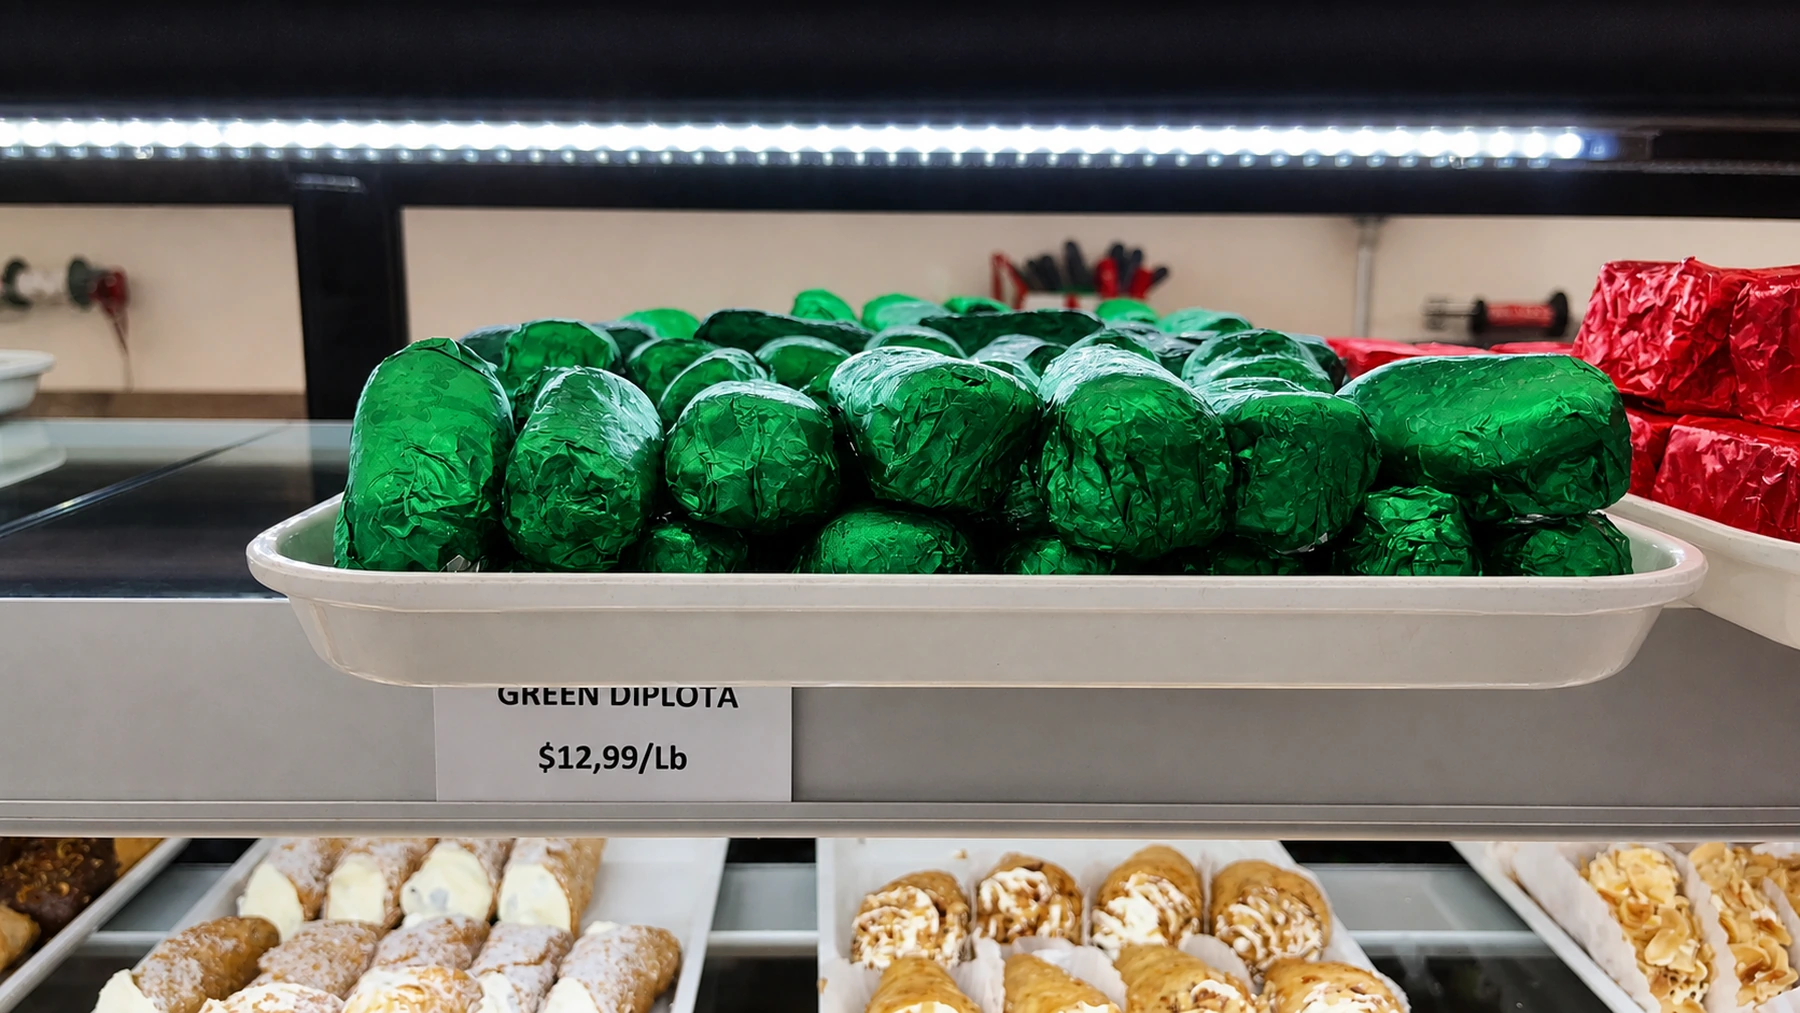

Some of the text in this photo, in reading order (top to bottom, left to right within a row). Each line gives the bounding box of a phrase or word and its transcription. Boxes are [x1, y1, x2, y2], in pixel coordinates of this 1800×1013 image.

[497, 686, 739, 709] GREEN DIPLOTA
[538, 741, 688, 775] $12,99/Lb
